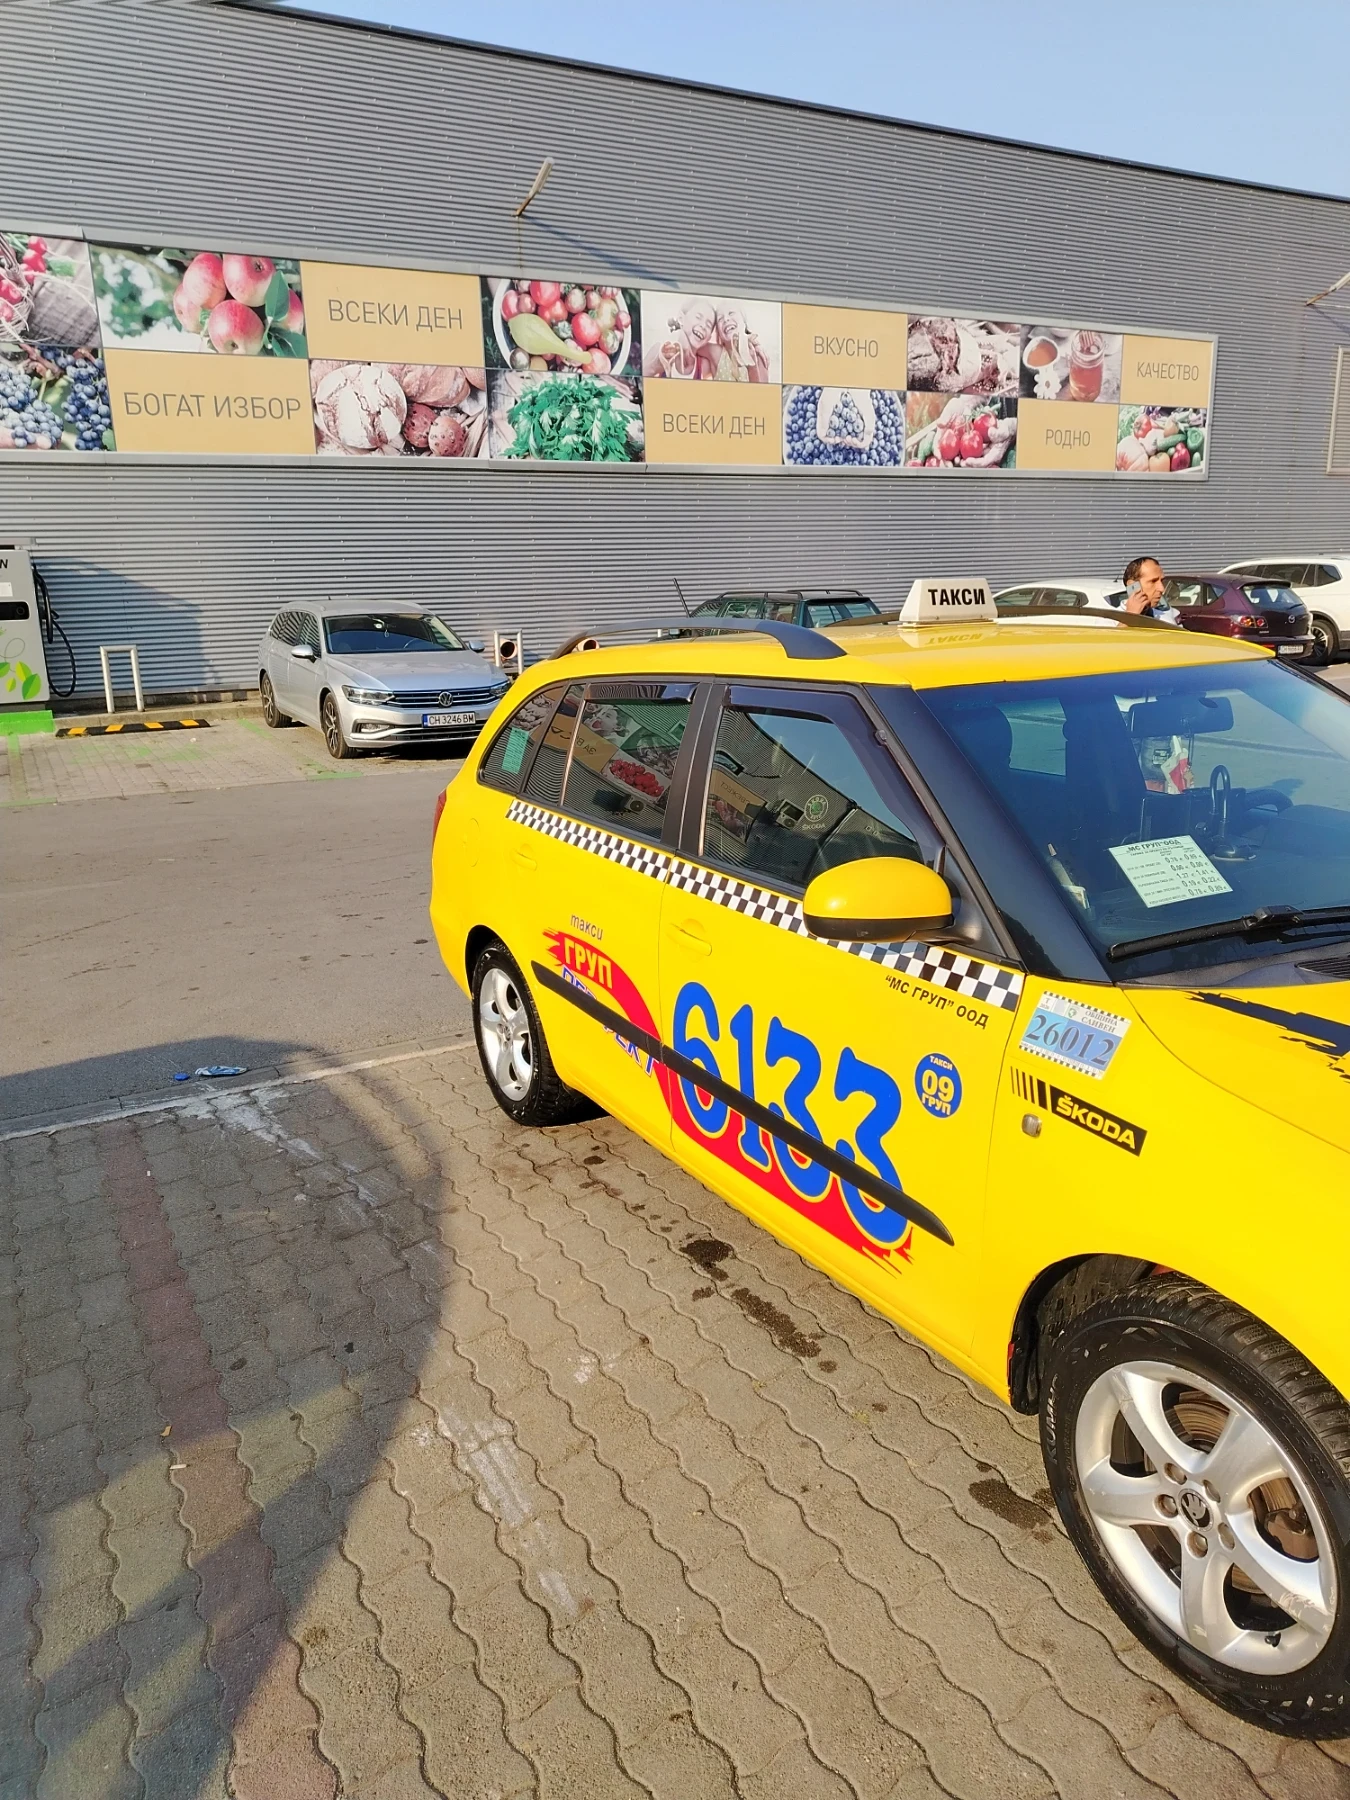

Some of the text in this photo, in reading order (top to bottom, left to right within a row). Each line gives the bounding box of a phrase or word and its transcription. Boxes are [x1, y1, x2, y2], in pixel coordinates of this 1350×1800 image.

[328, 298, 464, 331] ВСЕКИ ДЕН
[814, 335, 879, 359] ВКУСНО
[1136, 361, 1199, 381] КАЧЕСТВО
[125, 391, 301, 420] БОГАТ ИЗБОР
[663, 412, 766, 438] ВСЕКИ ДЕН
[1045, 428, 1091, 448] РОДНО
[928, 588, 986, 606] ТАКСИ
[564, 937, 613, 989] ГРУП
[956, 1005, 990, 1029] ООД
[1081, 1016, 1116, 1033] СЛИВЕН
[1085, 1010, 1119, 1027] ОБЩИНА
[1025, 1014, 1115, 1066] 26012
[929, 1055, 953, 1071] ТАКСИ
[921, 1069, 955, 1102] 09
[673, 981, 913, 1249] 6133
[921, 1092, 952, 1115] ГРУП
[1055, 1095, 1137, 1150] ŠKODA
